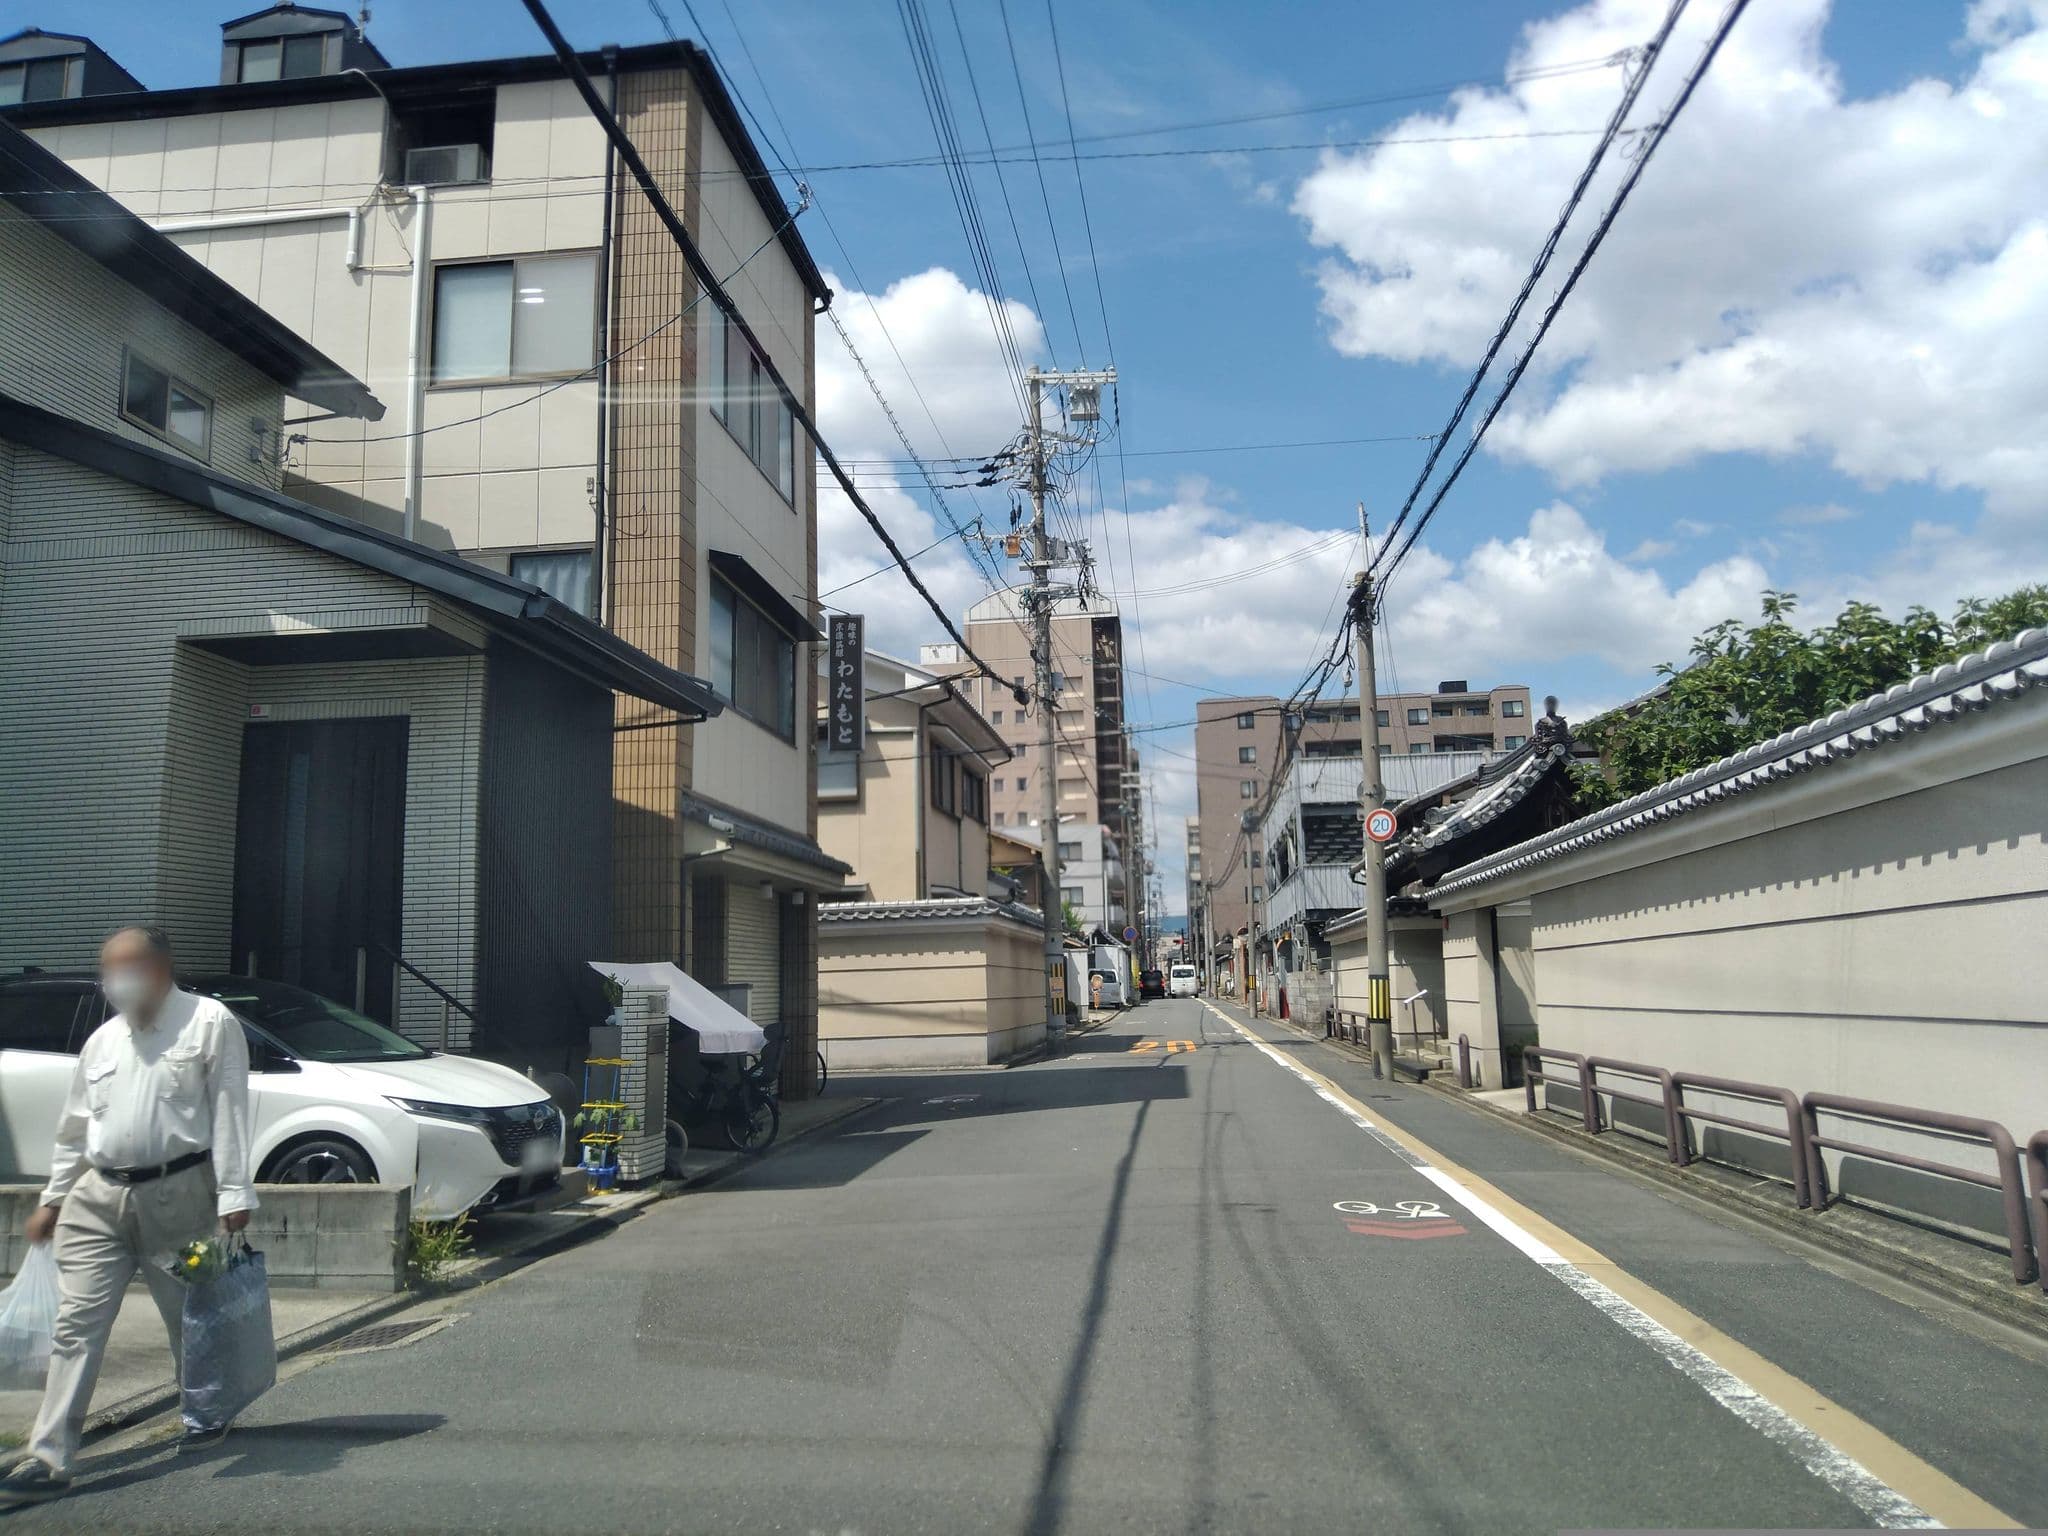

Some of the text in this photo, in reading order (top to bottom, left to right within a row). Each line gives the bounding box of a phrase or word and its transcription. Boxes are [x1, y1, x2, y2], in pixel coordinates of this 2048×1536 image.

[837, 660, 854, 743] わたもと
[1373, 818, 1389, 832] 20
